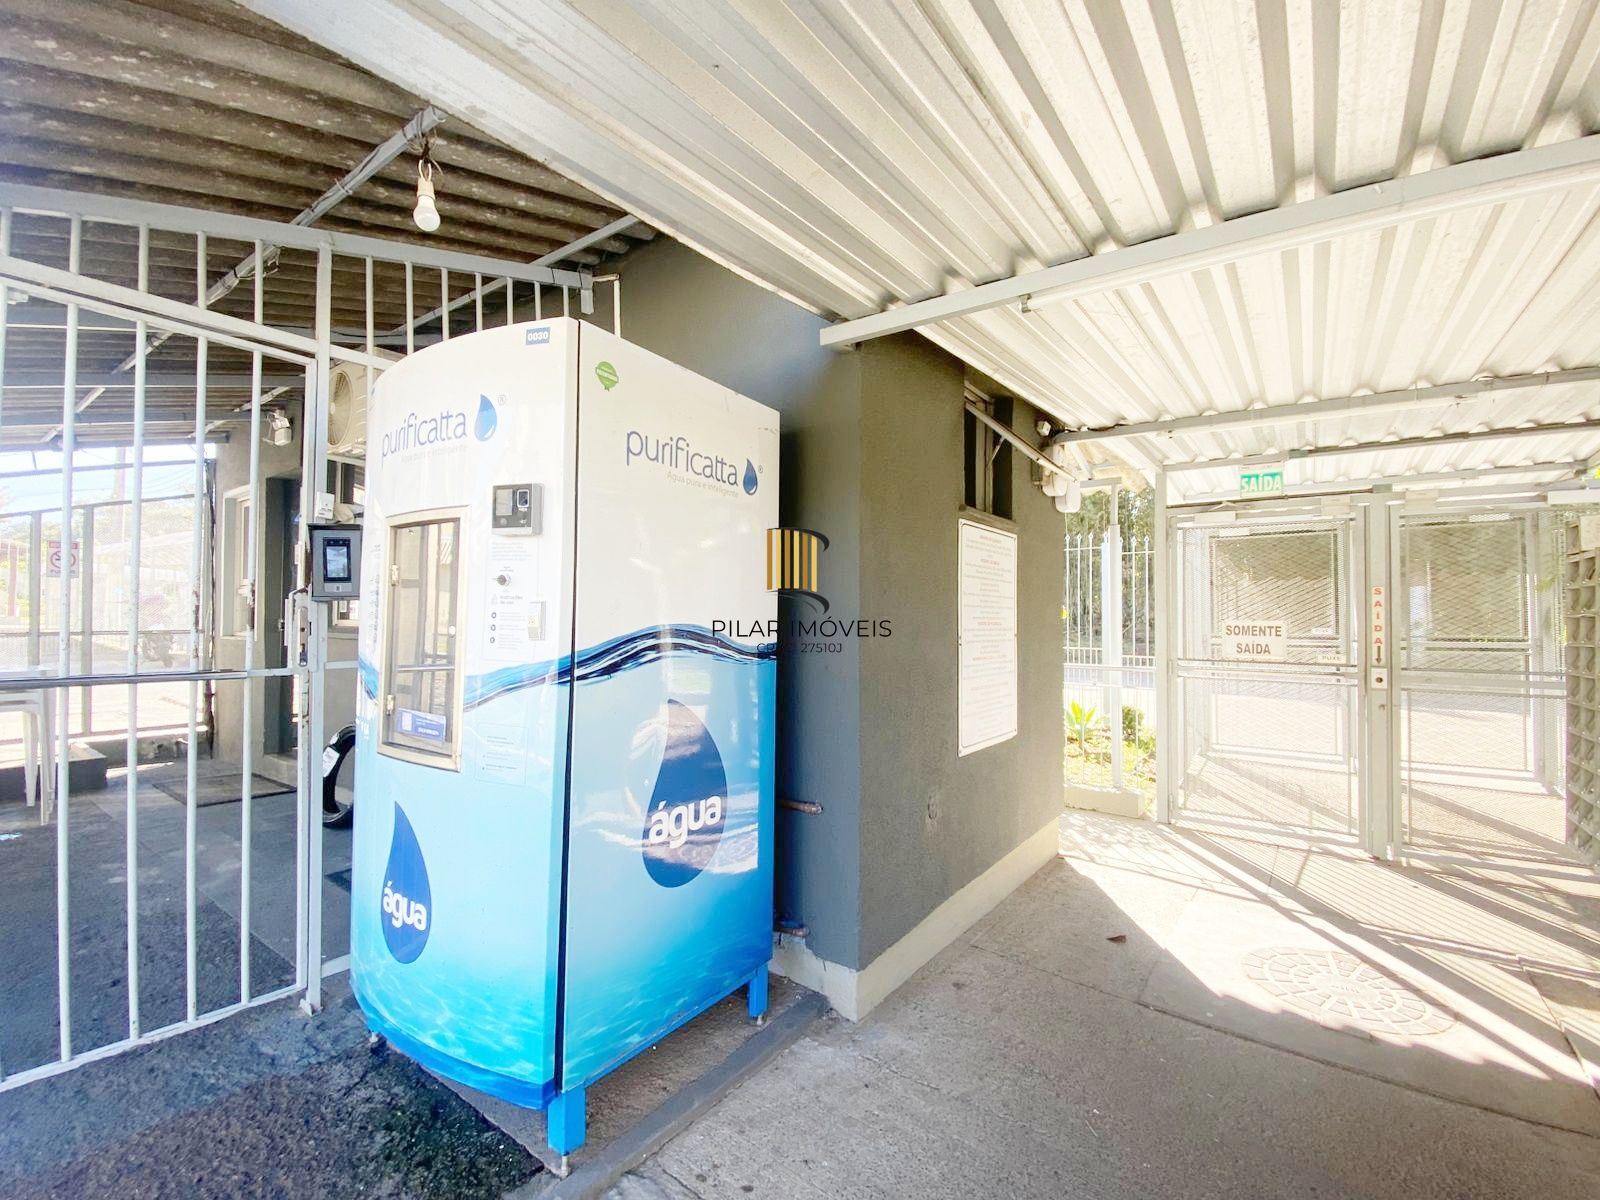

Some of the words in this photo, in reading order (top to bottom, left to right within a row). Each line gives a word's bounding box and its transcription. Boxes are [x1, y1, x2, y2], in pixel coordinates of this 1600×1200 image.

[381, 408, 468, 469] purificatta
[626, 430, 739, 487] purificatta
[1240, 473, 1281, 493] SAÍDA
[1225, 624, 1282, 637] SOMENTE
[1236, 640, 1271, 655] SAÍDA
[647, 793, 722, 848] água
[382, 880, 427, 931] água
